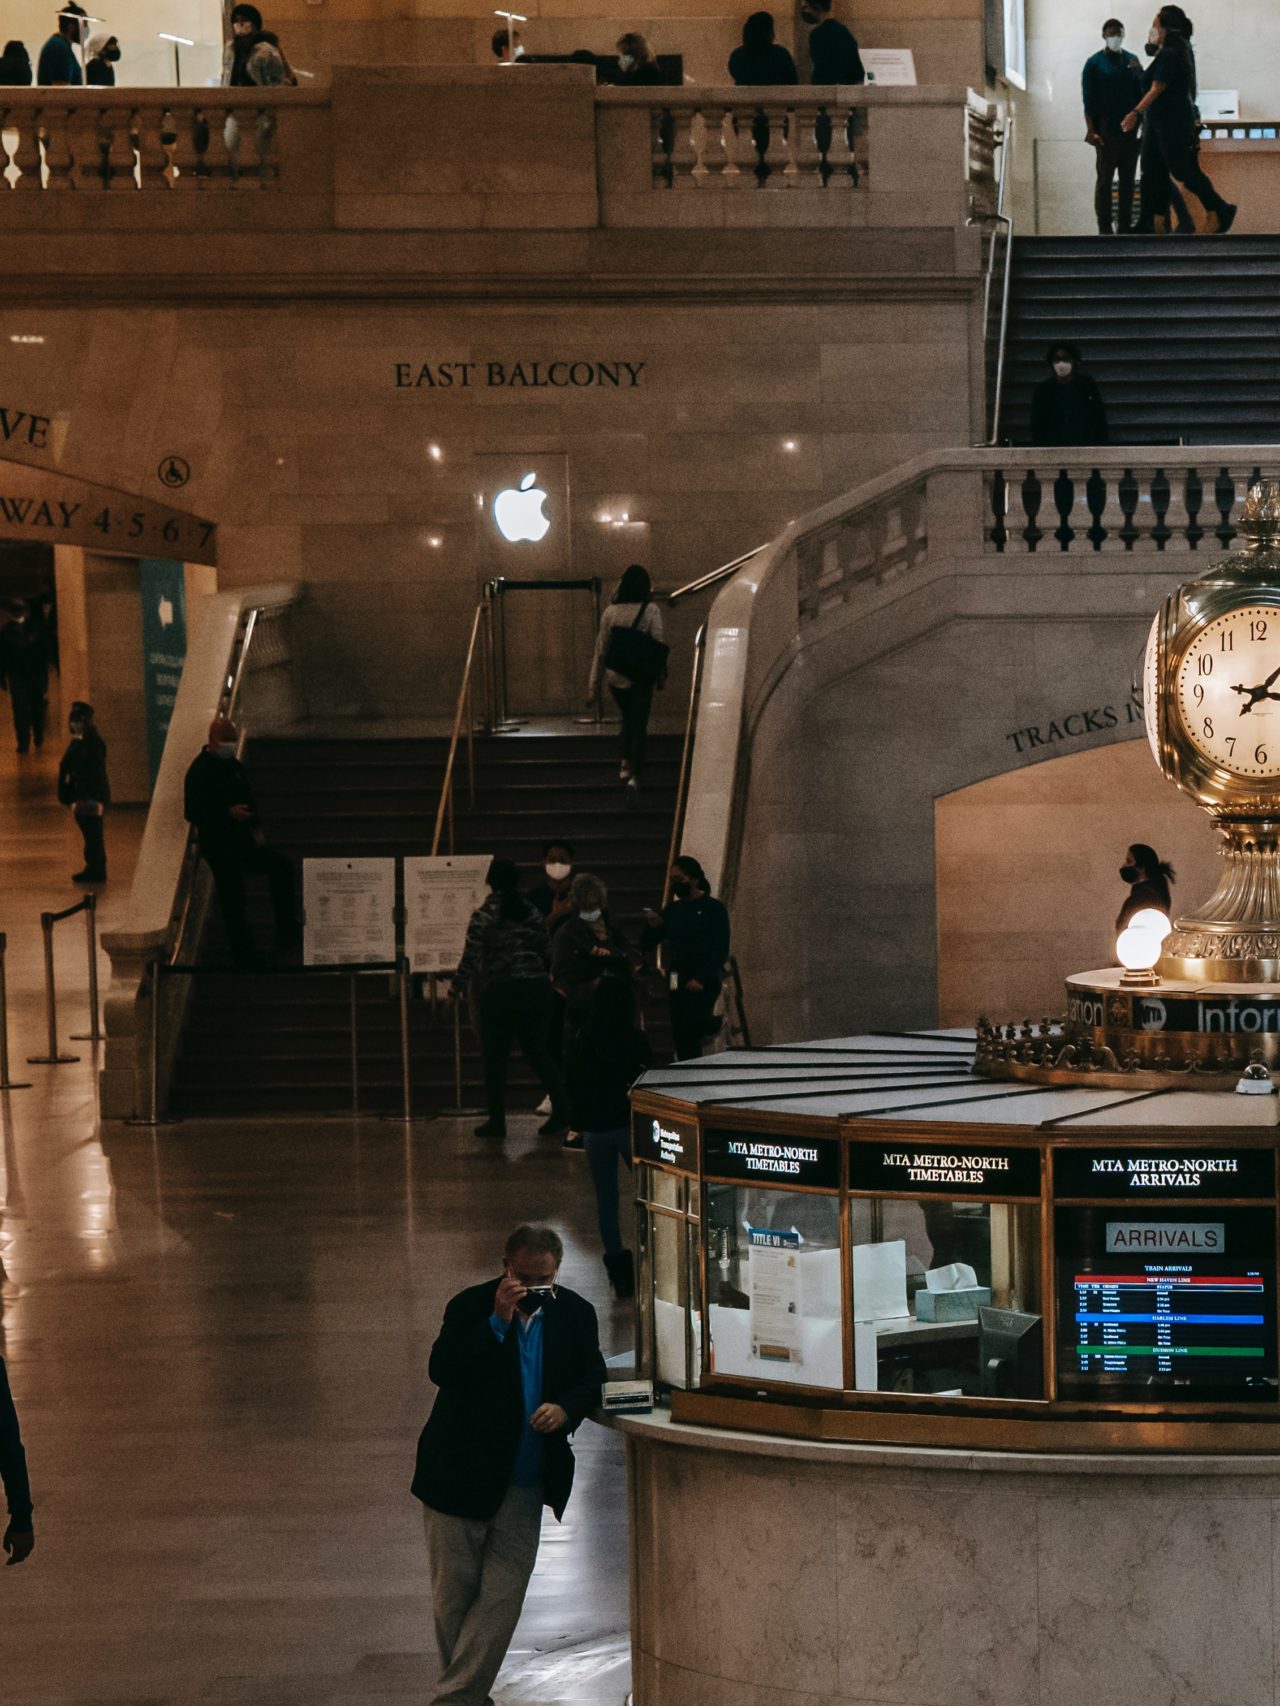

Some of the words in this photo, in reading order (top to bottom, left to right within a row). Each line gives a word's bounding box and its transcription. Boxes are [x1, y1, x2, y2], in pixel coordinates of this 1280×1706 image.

[394, 362, 475, 387] EAST
[486, 361, 645, 387] BALCONY
[1220, 630, 1233, 651] 11
[1250, 620, 1267, 641] 12
[1197, 653, 1213, 676] 10
[1193, 684, 1204, 708] 9
[1006, 705, 1118, 753] TRACKS
[1203, 717, 1214, 739] 8
[1225, 736, 1236, 757] 7
[1255, 743, 1268, 764] 6
[728, 1141, 748, 1155] MTA
[749, 1143, 818, 1161] METRO-NORTH
[883, 1153, 910, 1167] MTA
[913, 1154, 1009, 1170] METRO-NORTH
[746, 1158, 800, 1174] TIMETABLES
[908, 1168, 984, 1183] TIMETABLES
[1092, 1159, 1124, 1172] MTA
[1127, 1159, 1238, 1172] METRO-NORTH
[1130, 1173, 1201, 1186] ARRIVALS
[753, 1233, 772, 1246] TITLE
[772, 1235, 780, 1247] VI
[1113, 1230, 1218, 1247] ARRIVALS
